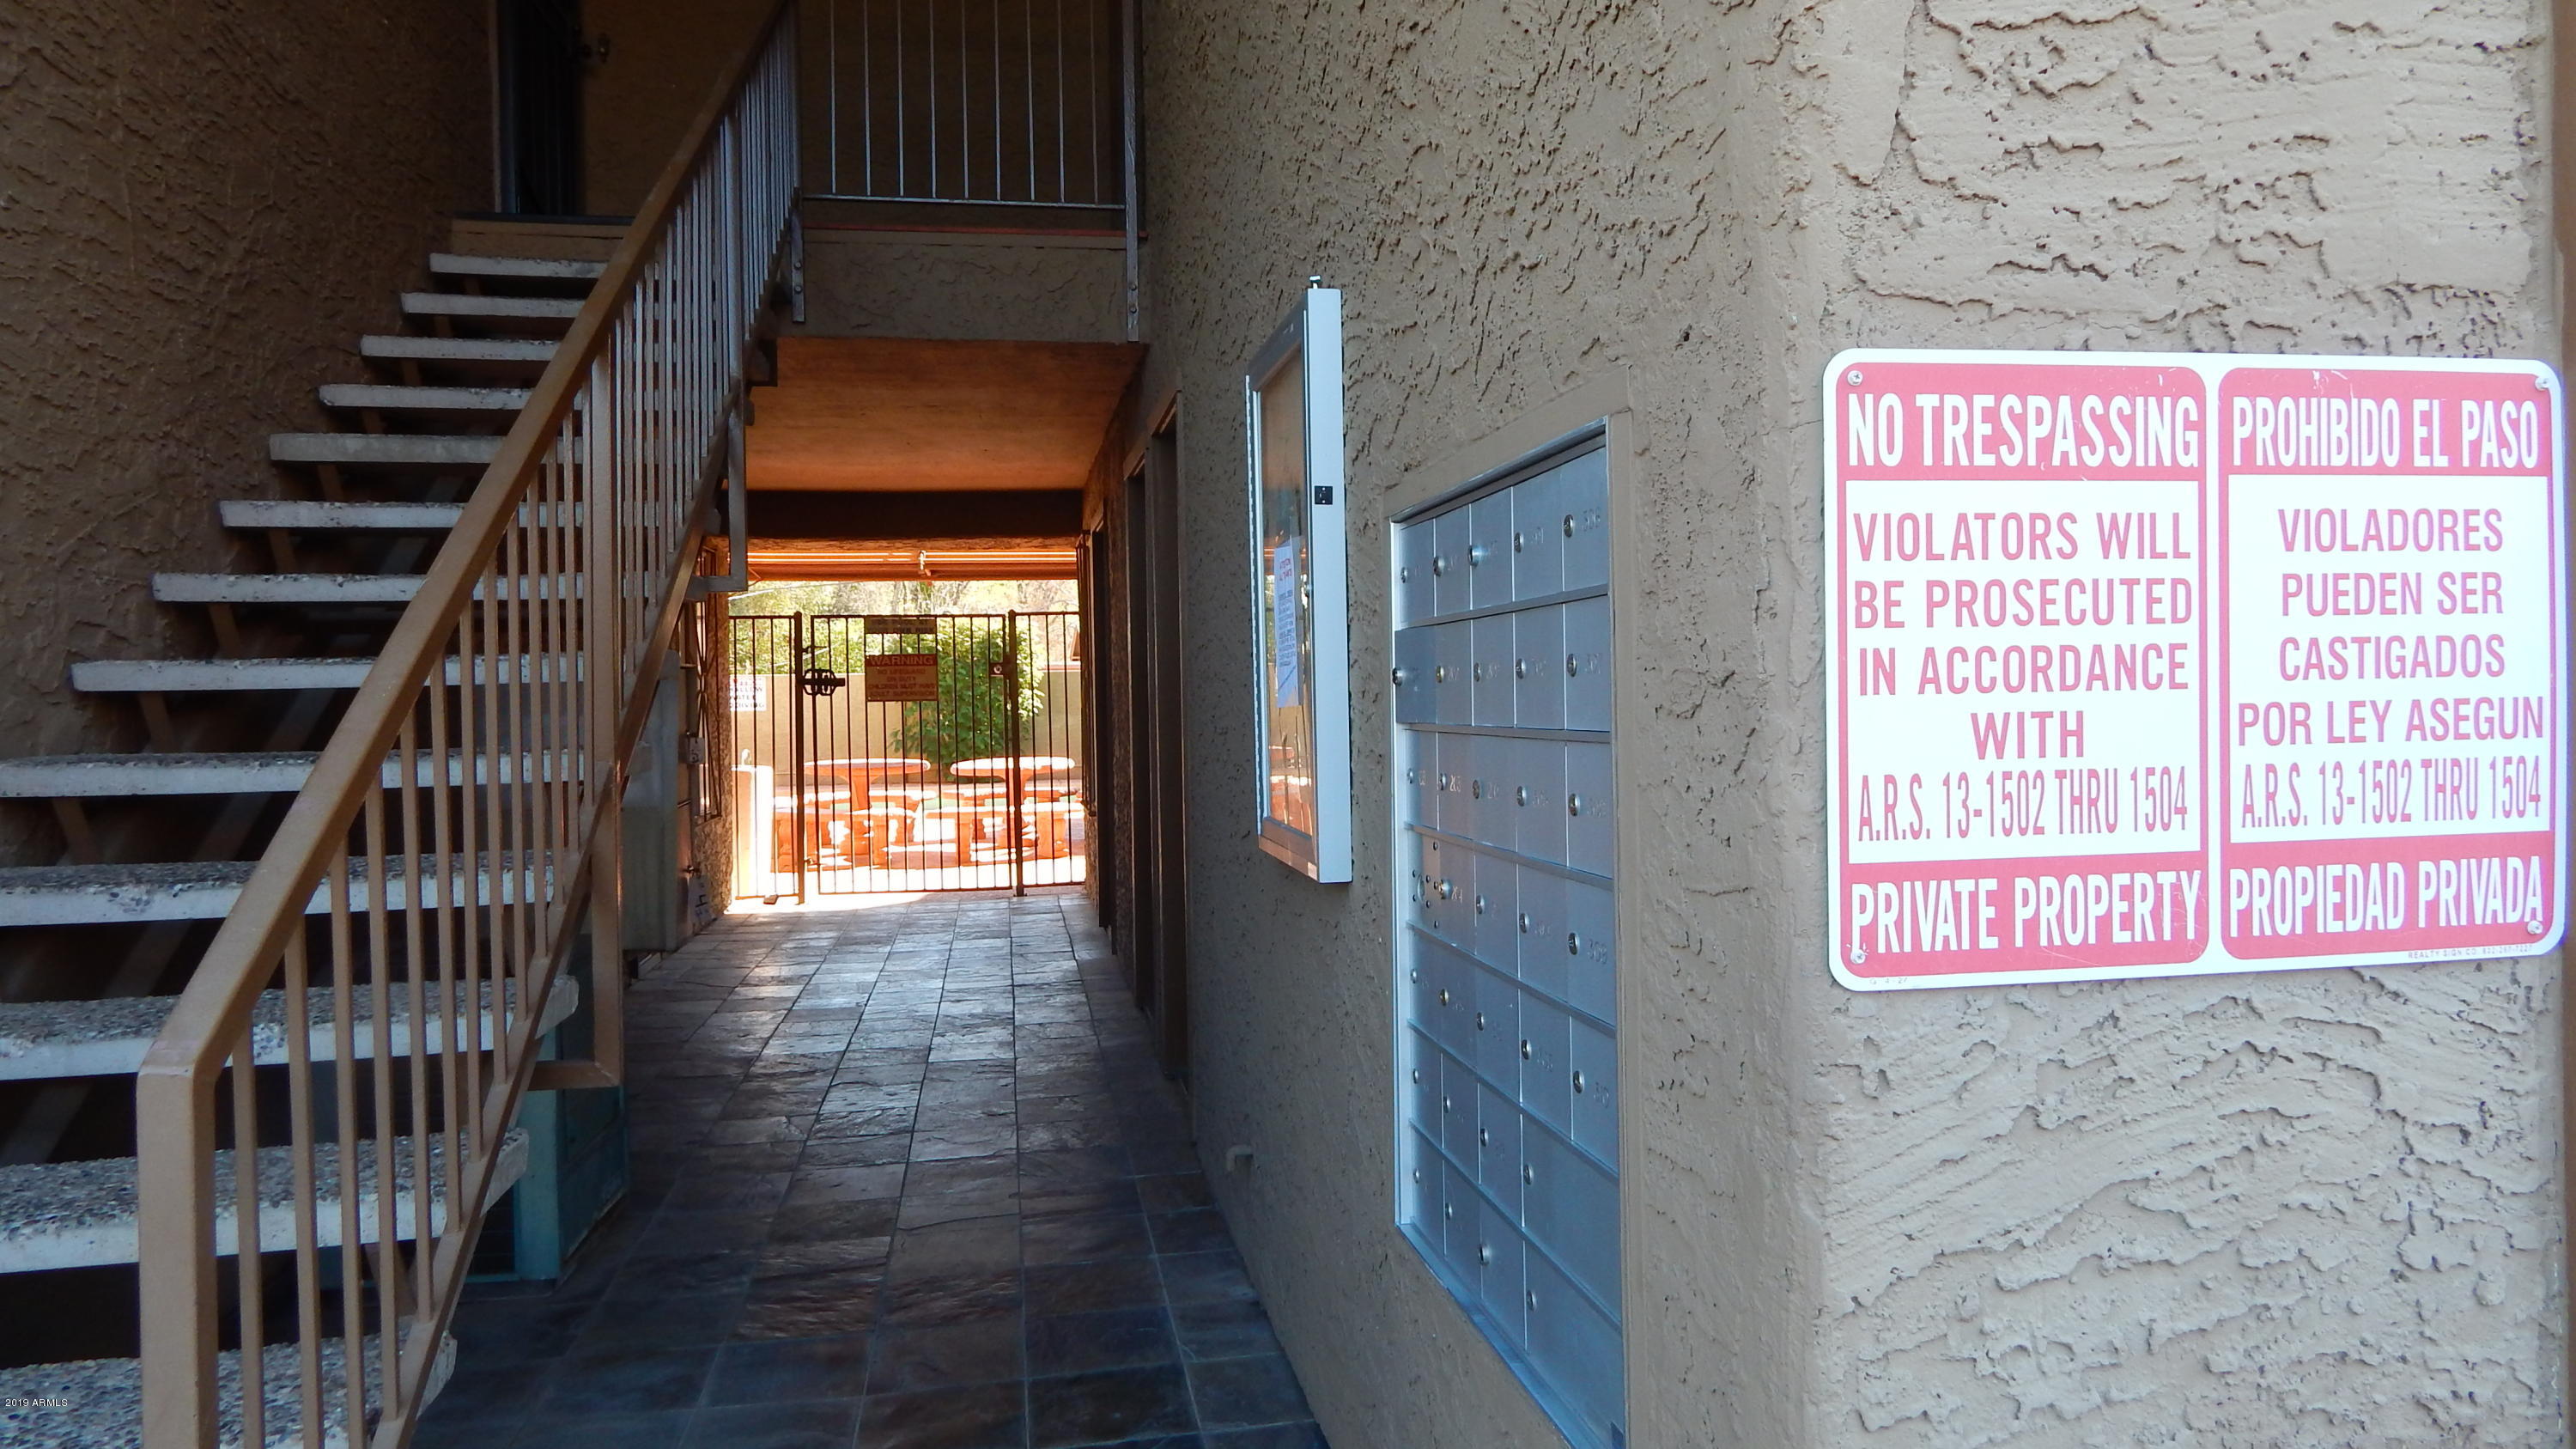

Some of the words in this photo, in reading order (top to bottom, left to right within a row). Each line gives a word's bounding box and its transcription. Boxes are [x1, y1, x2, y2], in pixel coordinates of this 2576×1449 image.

[1849, 393, 1903, 466] NO
[1916, 394, 2198, 467] TRESPASSING
[2233, 399, 2399, 467] PROHIBIDO
[2414, 399, 2448, 466] EL
[2462, 400, 2537, 468] PASO
[1853, 512, 2078, 561] VIOLATORS
[2096, 513, 2190, 559] WILL
[2278, 508, 2503, 552] VIOLADORES
[1855, 581, 1905, 628] BE
[1926, 578, 2191, 628] PROSECUTED
[2282, 572, 2421, 617] PUEDEN
[2438, 571, 2503, 615] SER
[870, 656, 933, 665] WARNING
[1860, 648, 1895, 696] IN
[1918, 643, 2188, 694] ACCORDANCE
[2280, 635, 2505, 681] CASTIGADOS
[1971, 710, 2083, 760] WITH
[2239, 702, 2312, 746] POR
[2328, 700, 2391, 744] LEY
[2405, 697, 2543, 741] ASEGUN
[1858, 773, 1930, 842] A.R.S.
[1943, 770, 2044, 838] 13-1502
[2055, 768, 2117, 834] THRU
[2130, 766, 2187, 831] 1504
[2242, 763, 2307, 828] A.R.S.
[2319, 759, 2412, 825] 13-1502
[2421, 758, 2478, 821] THRU
[2489, 756, 2541, 819] 1504
[1850, 879, 1998, 953] PRIVATE
[2015, 870, 2201, 947] PROPERTY
[2230, 862, 2404, 937] PROPIEDAD
[2419, 856, 2543, 928] PRIVADA
[2408, 948, 2439, 959] REALTY
[2443, 947, 2462, 957] SIGN
